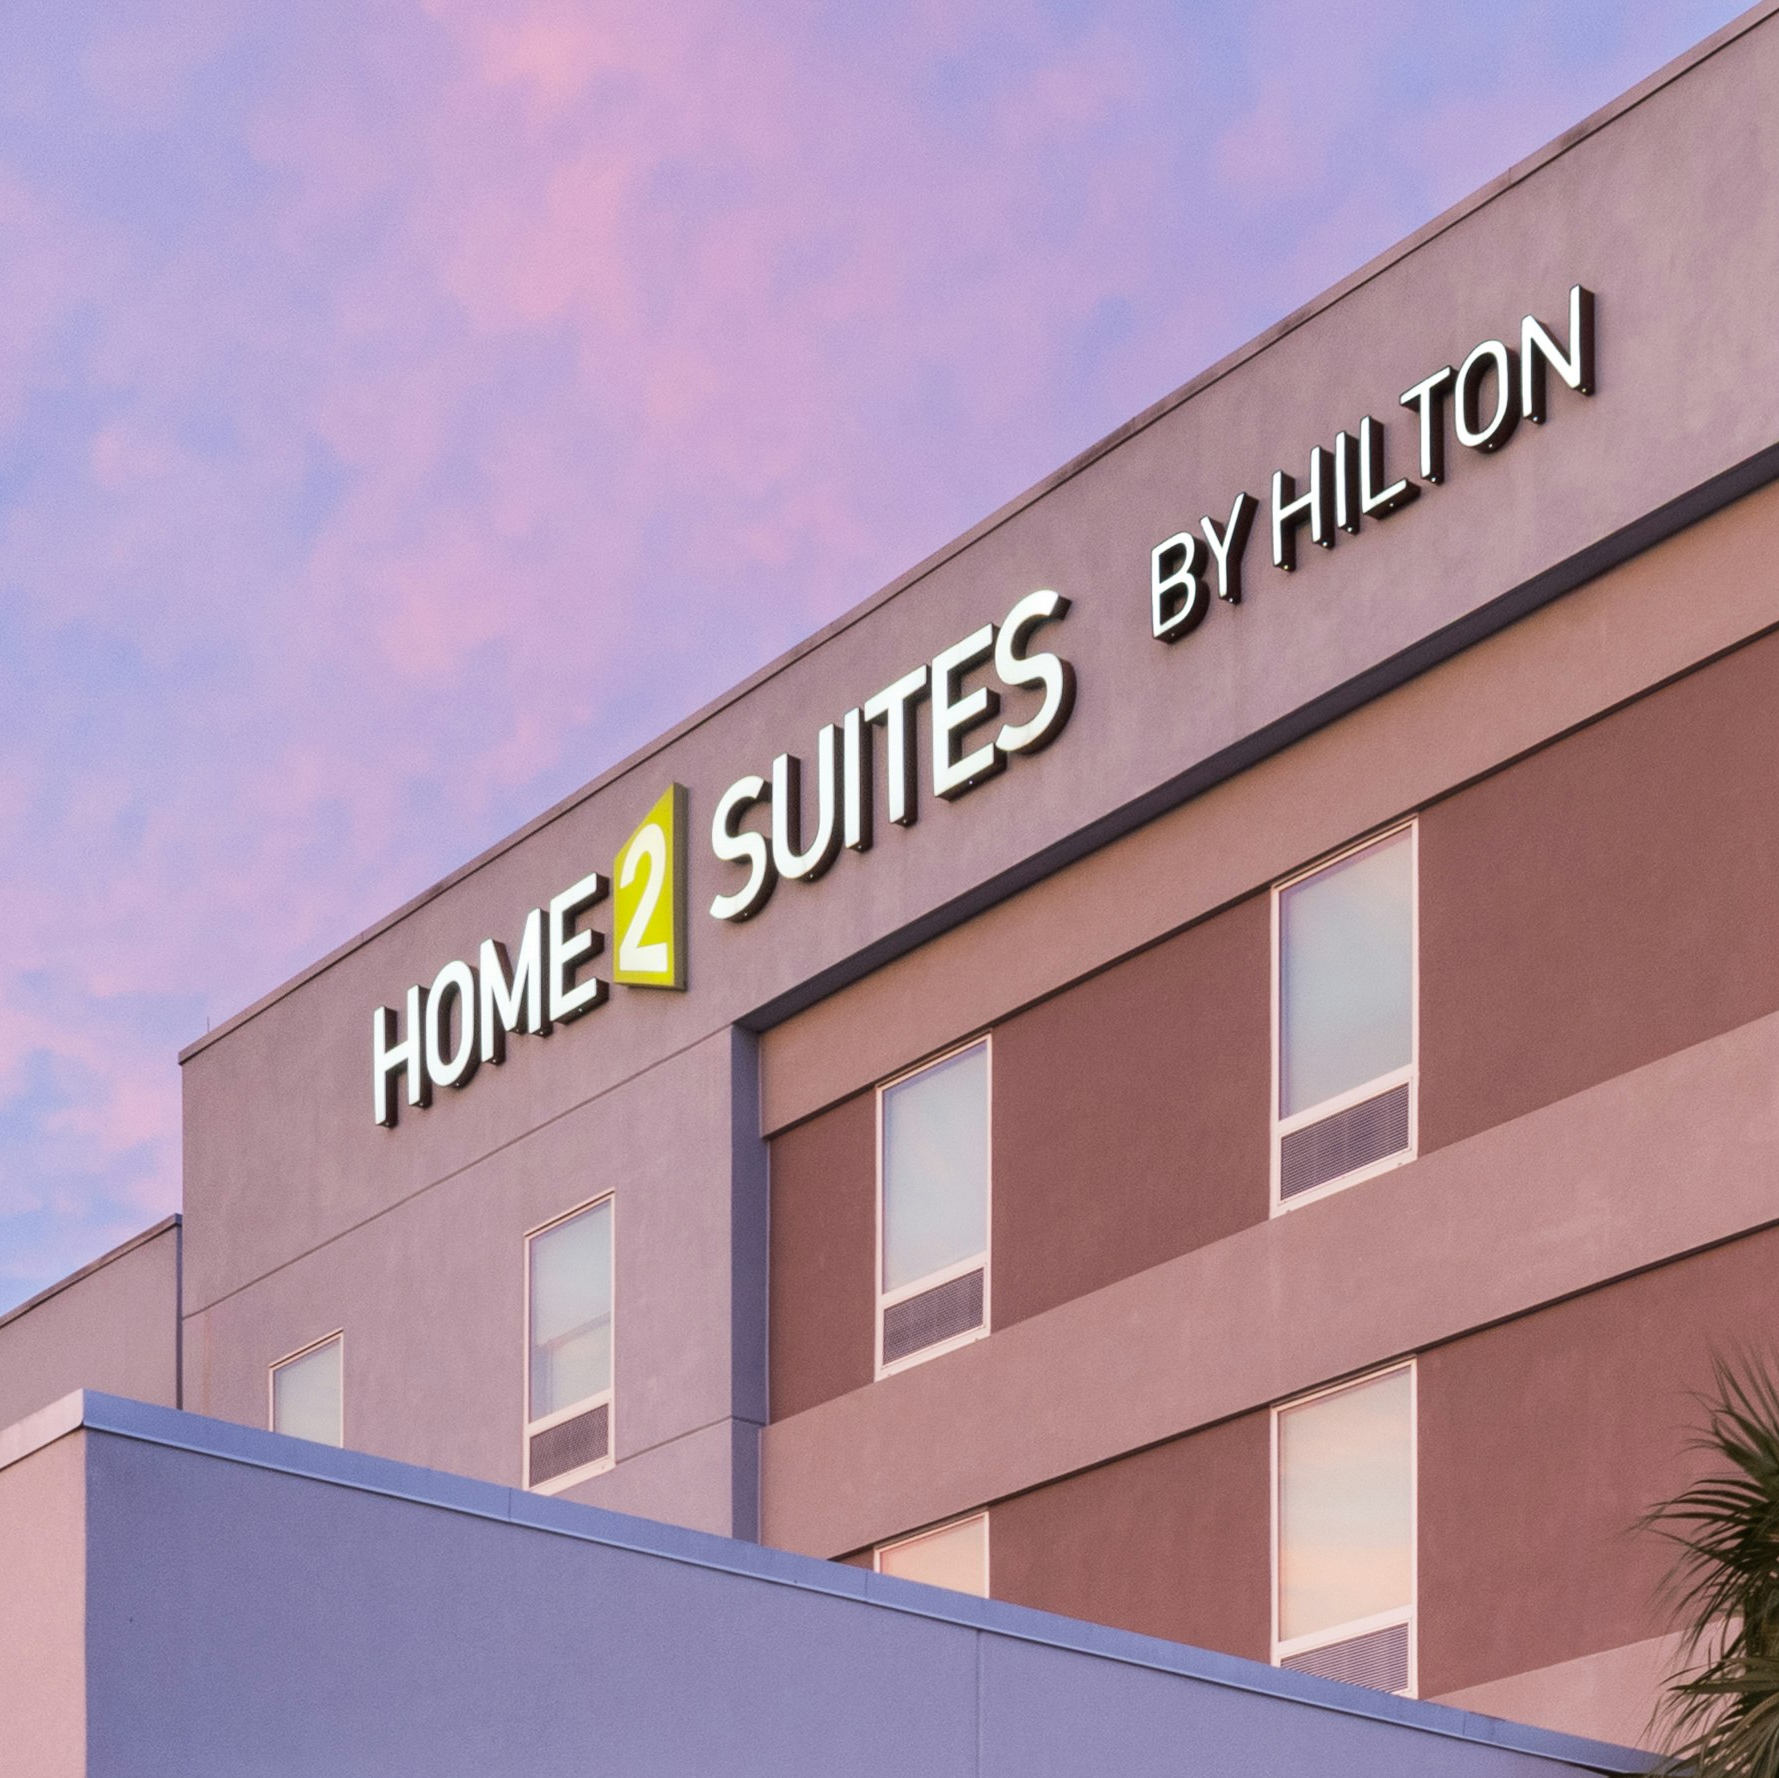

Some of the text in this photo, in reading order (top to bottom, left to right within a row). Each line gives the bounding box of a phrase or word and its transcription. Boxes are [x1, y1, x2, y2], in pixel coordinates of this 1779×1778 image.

[709, 588, 1072, 921] SUITES
[1151, 491, 1256, 641] BY
[1272, 284, 1590, 569] HILTON
